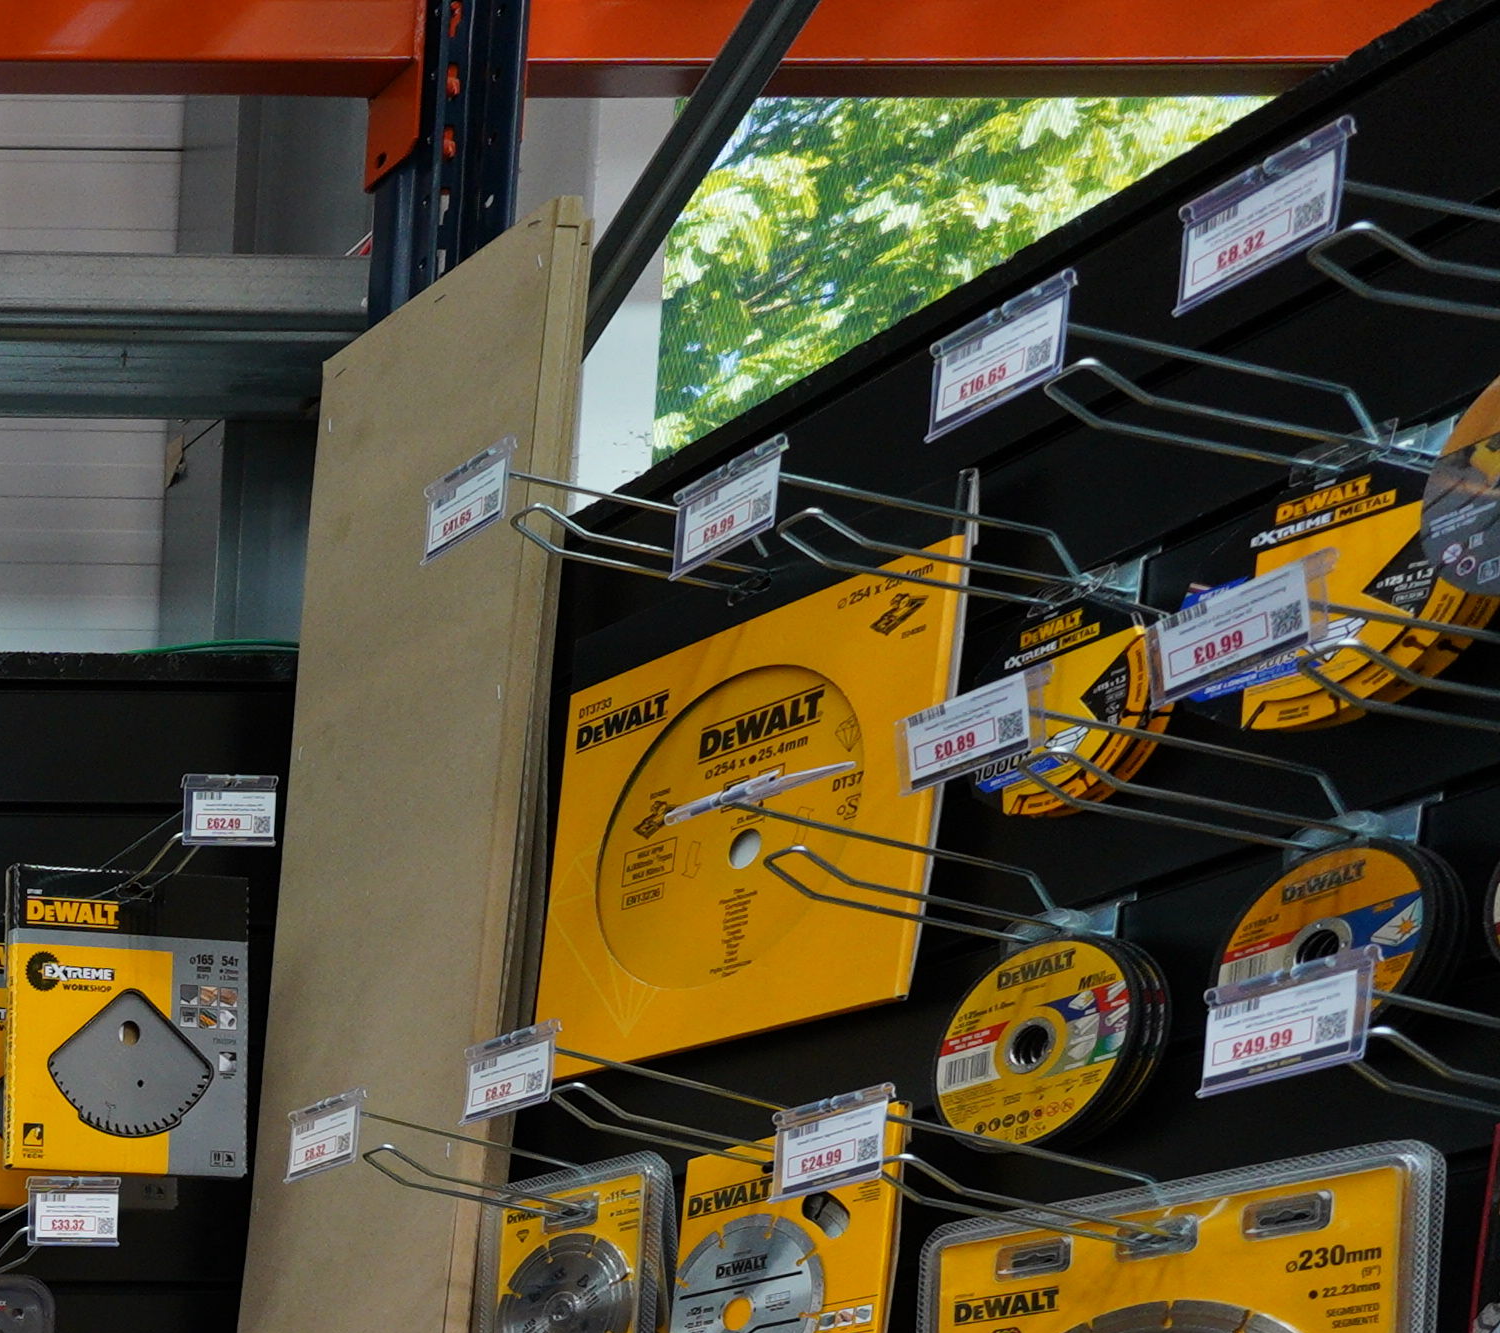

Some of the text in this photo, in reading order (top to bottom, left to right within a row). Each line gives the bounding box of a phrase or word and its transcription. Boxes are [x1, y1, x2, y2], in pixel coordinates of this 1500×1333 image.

[1217, 231, 1265, 269] £8.32
[960, 365, 1007, 400] £16.65
[1277, 476, 1371, 522] DEWALT
[703, 516, 735, 541] £9.99
[1020, 610, 1084, 649] DEWALT
[1194, 631, 1244, 664] £0.99
[576, 694, 669, 751] DEWALT
[699, 692, 826, 763] DEWALT
[935, 732, 976, 760] £0.89
[207, 818, 240, 830] £62.49
[27, 900, 119, 925] DEWALT
[42, 963, 113, 981] EXTREME
[998, 951, 1076, 988] DEWALT
[62, 984, 112, 993] WORKSHOP
[1233, 1029, 1293, 1059] £49.99
[800, 1149, 842, 1173] £24.99
[52, 1220, 87, 1231] £33.32
[954, 1292, 1058, 1326] DEWALT
